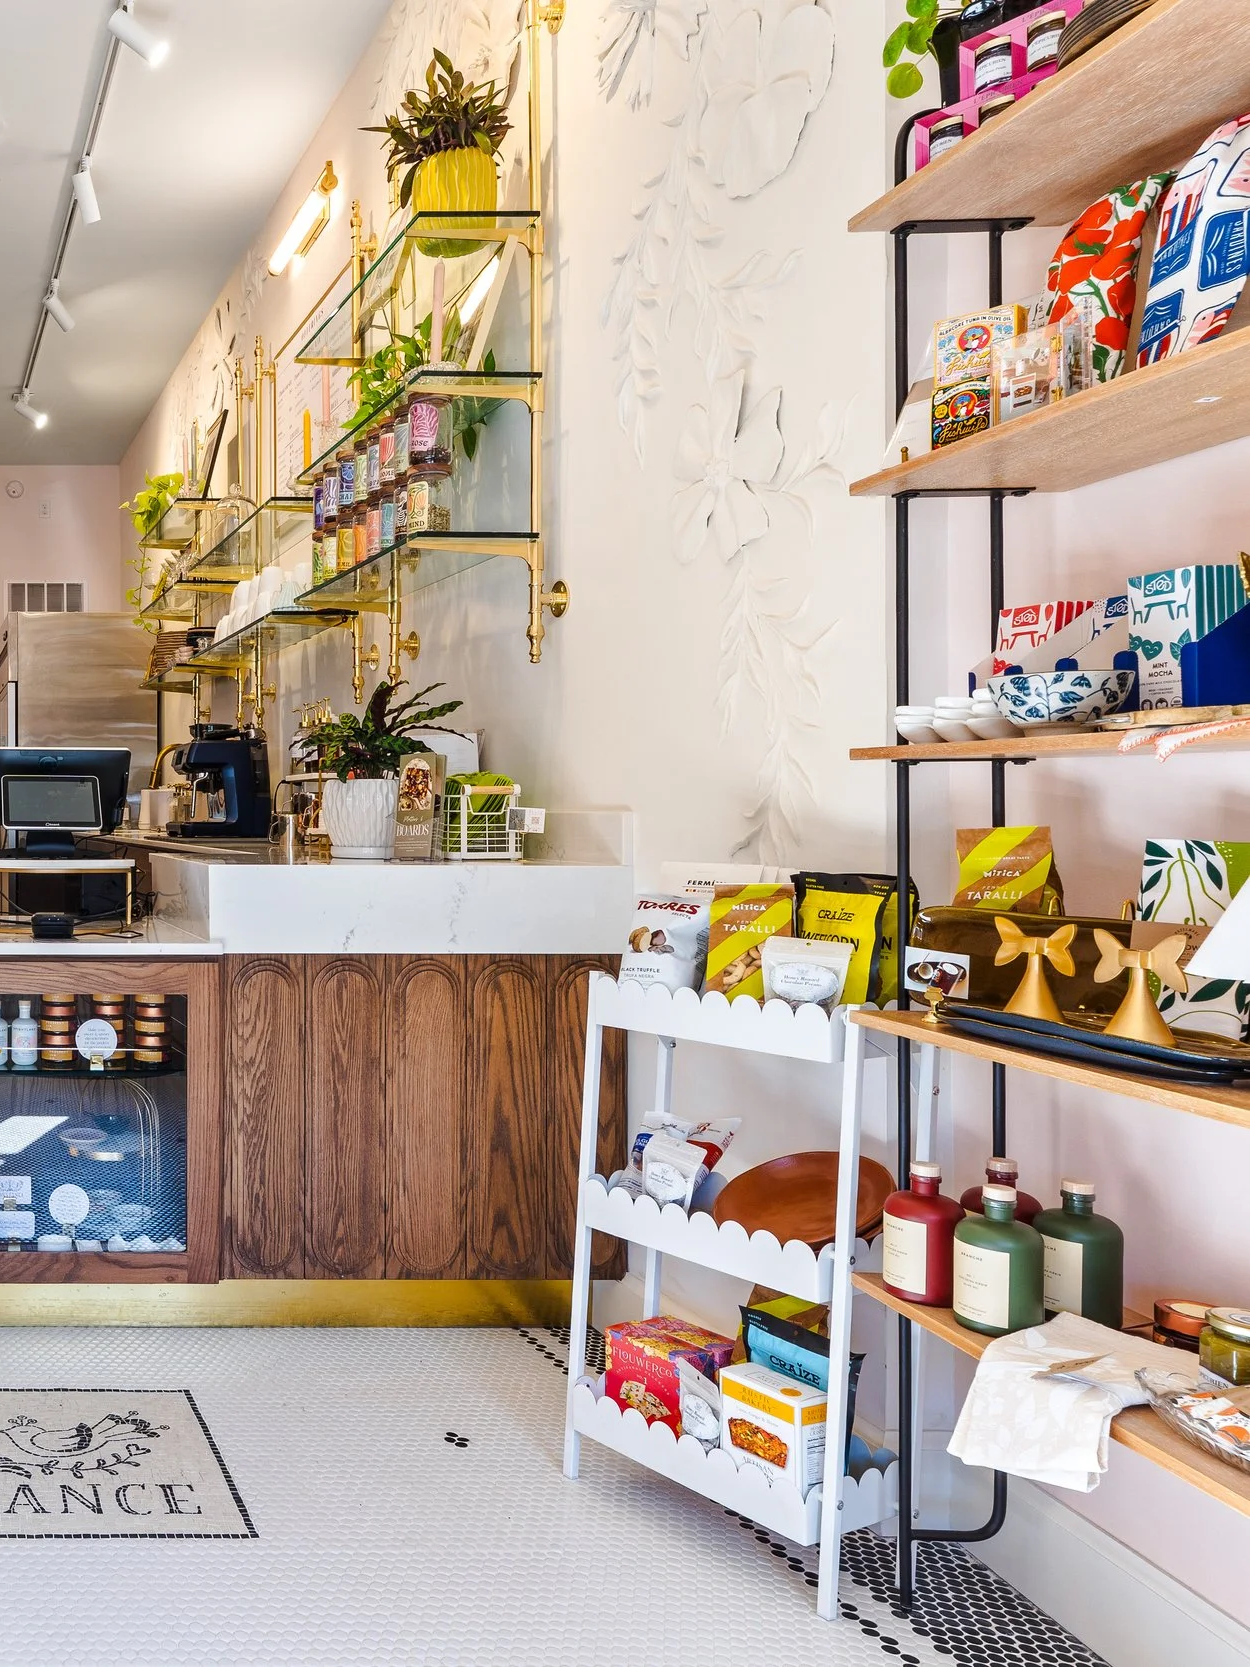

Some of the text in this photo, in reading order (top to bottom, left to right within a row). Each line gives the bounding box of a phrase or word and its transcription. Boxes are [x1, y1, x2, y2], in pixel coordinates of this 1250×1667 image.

[1148, 670, 1173, 678] MOCHA
[396, 823, 430, 837] BOARDS
[967, 891, 1023, 900] TARALLI
[638, 900, 701, 915] TORRES
[723, 923, 776, 933] TARALLI
[770, 1354, 821, 1386] CRAIZE
